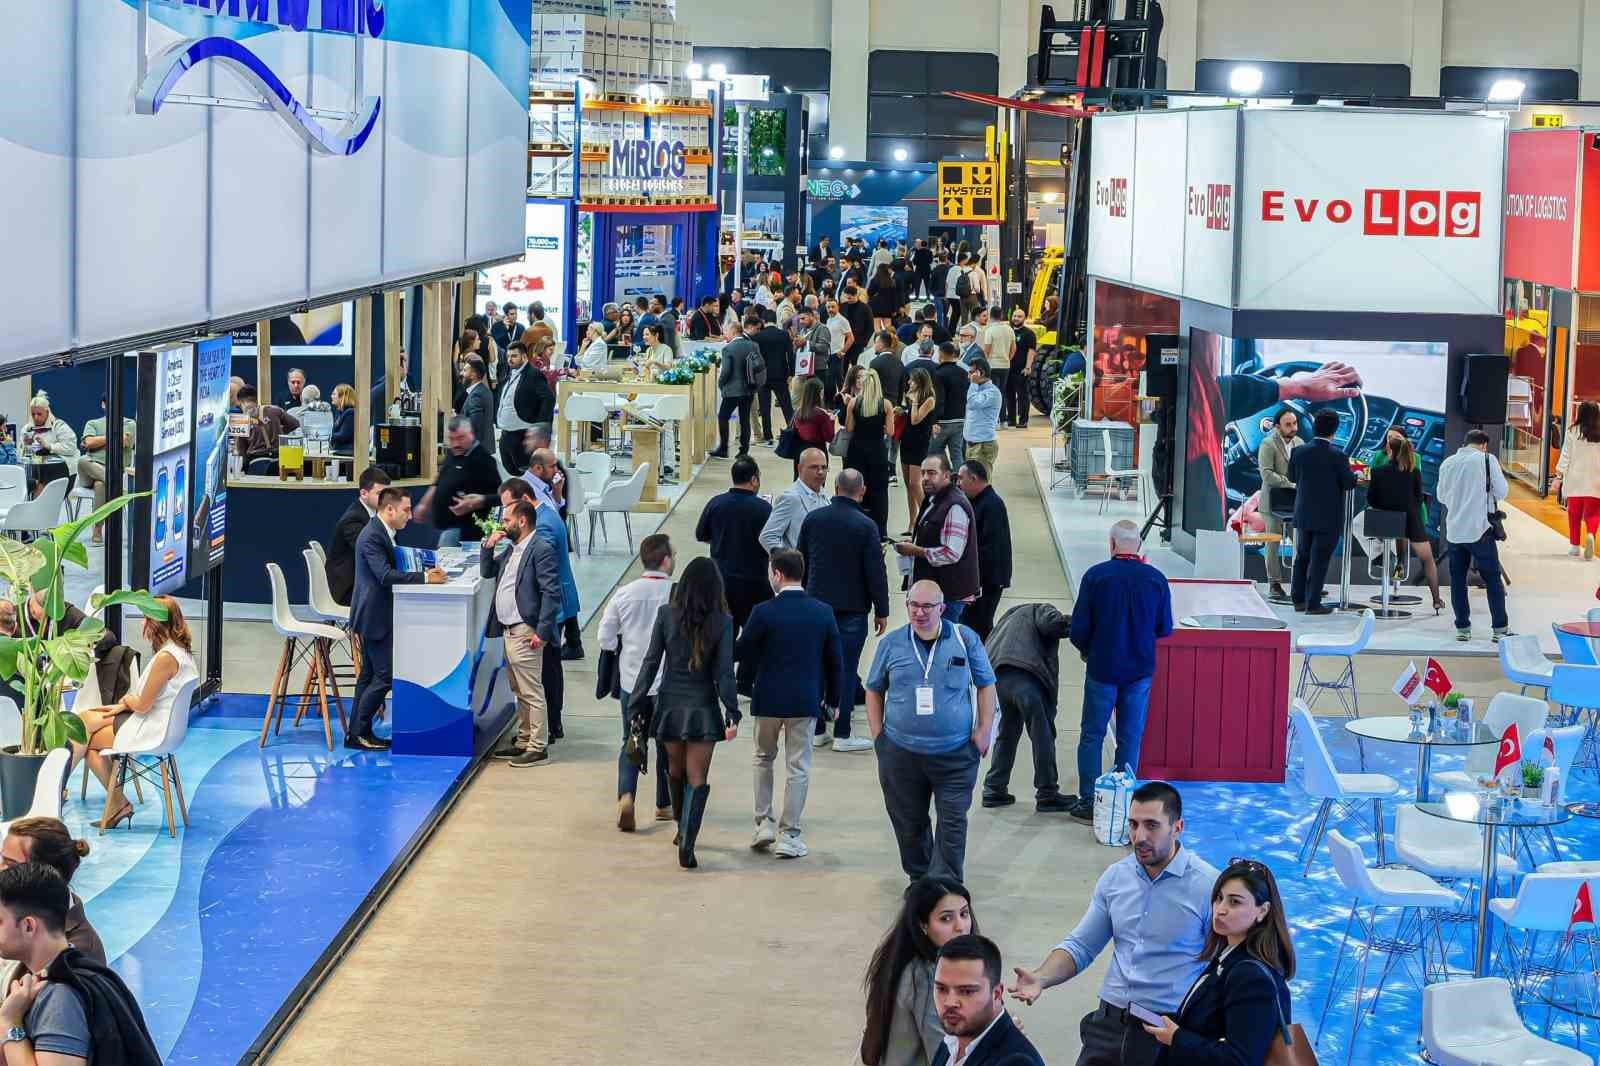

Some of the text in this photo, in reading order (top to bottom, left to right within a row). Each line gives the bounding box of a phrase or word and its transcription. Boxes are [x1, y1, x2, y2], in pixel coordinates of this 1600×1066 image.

[943, 186, 992, 196] HYSTER
[1097, 178, 1128, 218] EvoLog
[1188, 184, 1232, 231] EvoLog
[1525, 194, 1534, 217] OF
[1534, 194, 1568, 221] LOGISTICS
[1262, 189, 1482, 238] EvoLog
